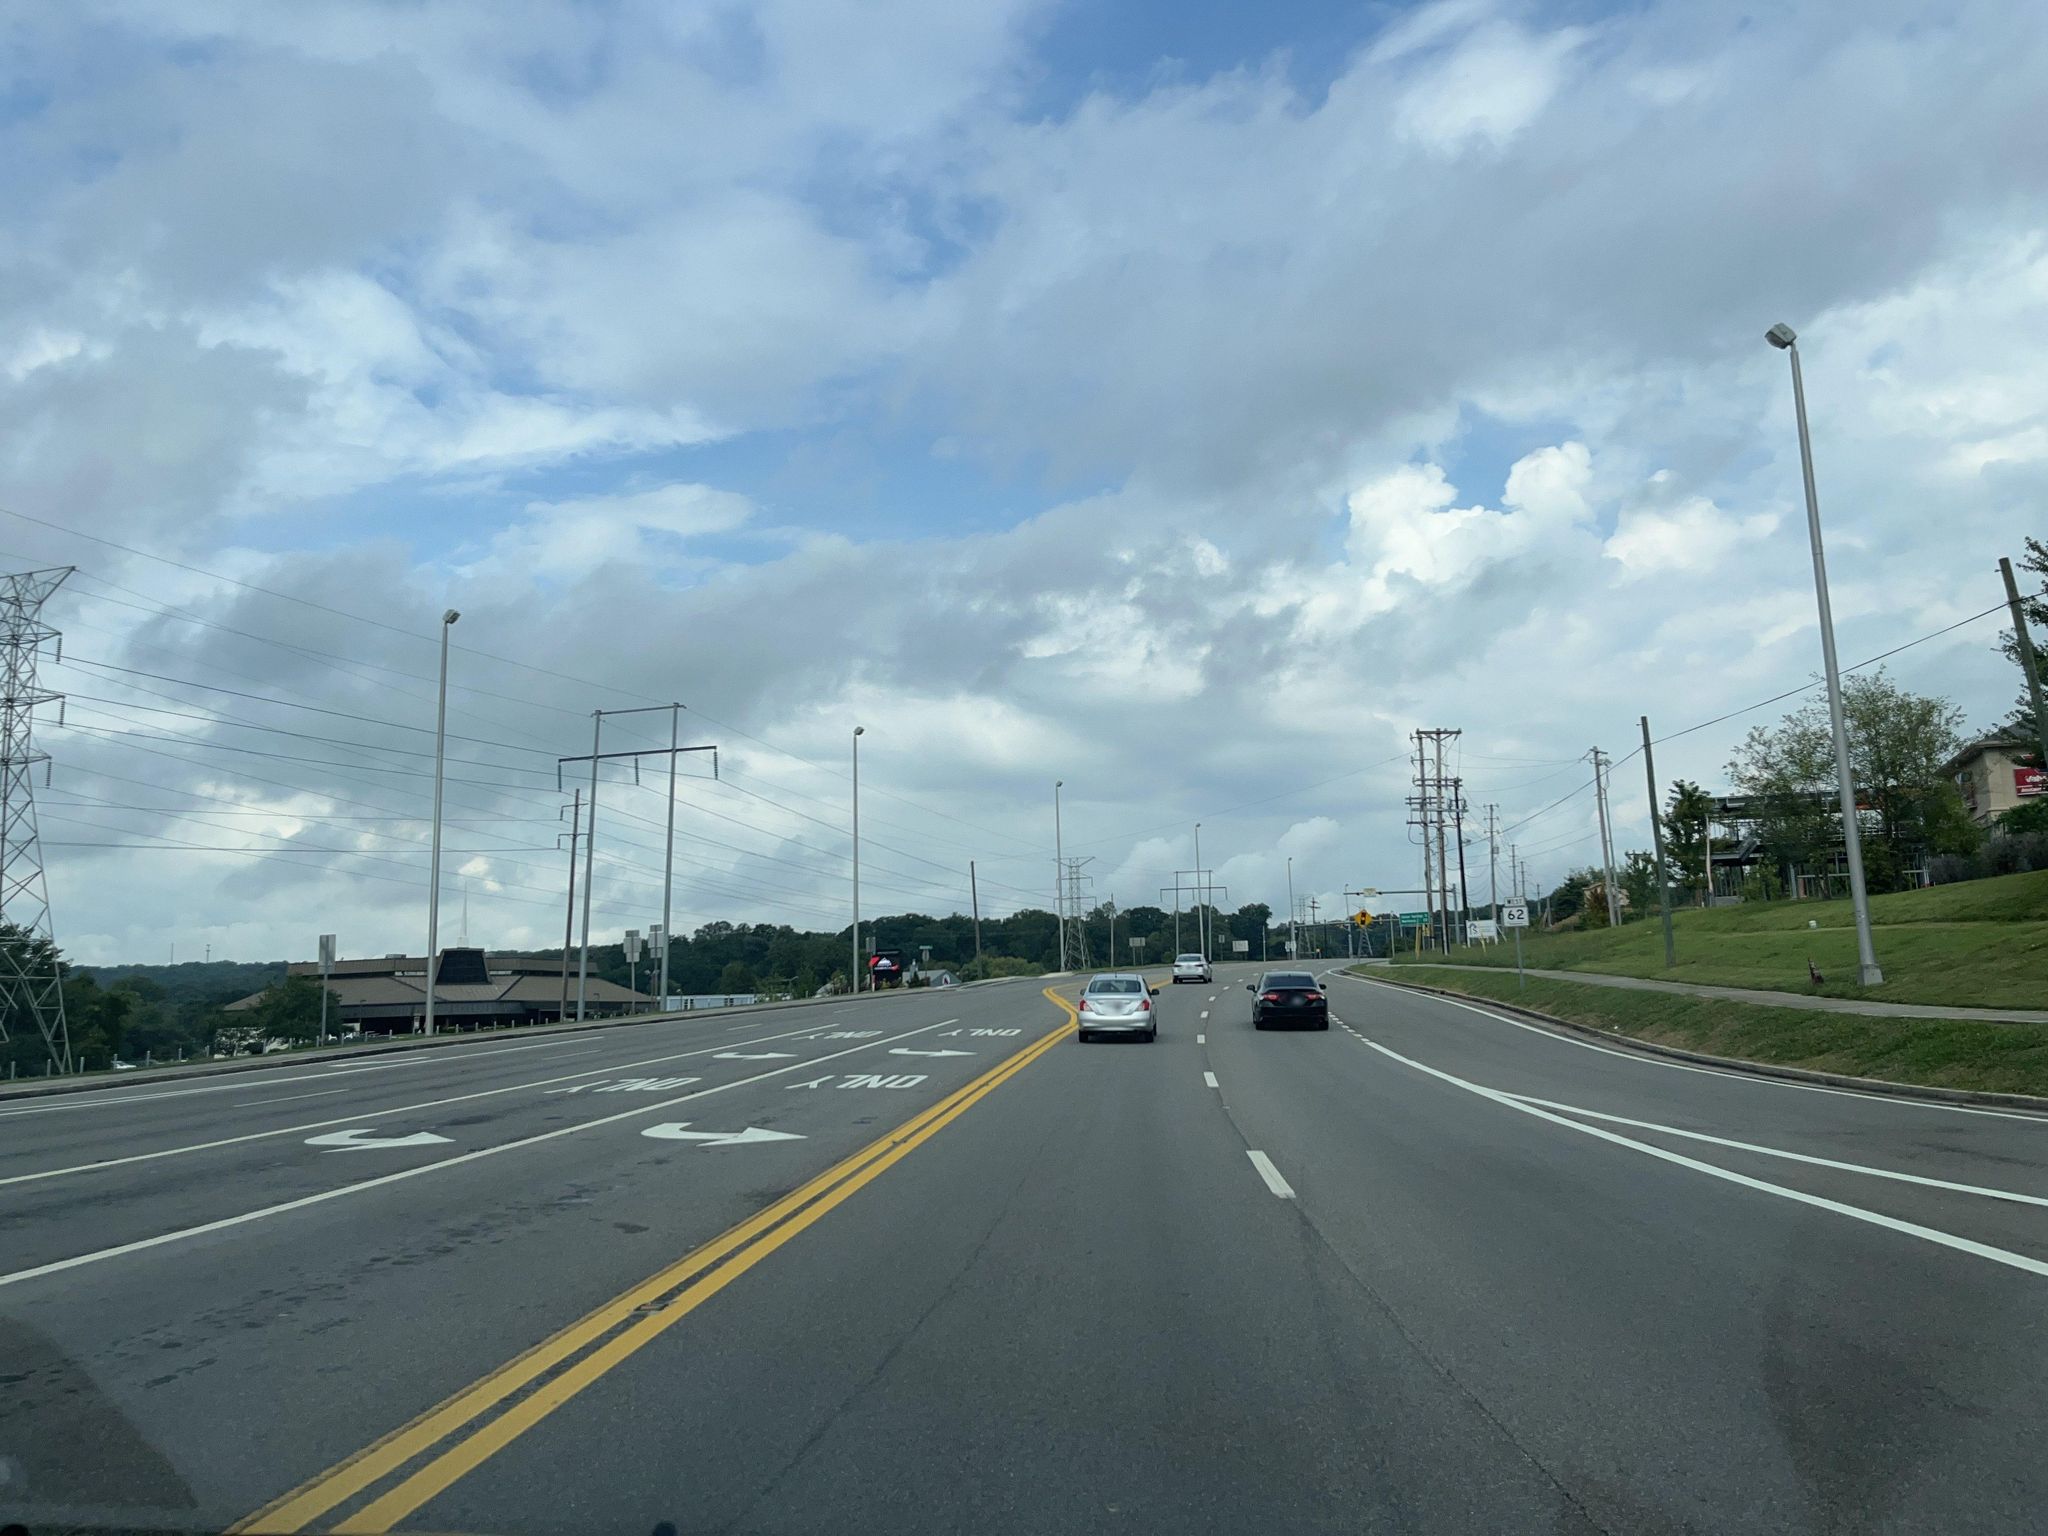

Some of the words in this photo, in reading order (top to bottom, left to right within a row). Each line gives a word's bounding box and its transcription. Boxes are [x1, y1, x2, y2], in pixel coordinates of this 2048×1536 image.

[1507, 909, 1525, 920] 62
[938, 1028, 1023, 1037] ONLY
[543, 1076, 702, 1094] ONLY
[785, 1074, 929, 1090] ONLY
